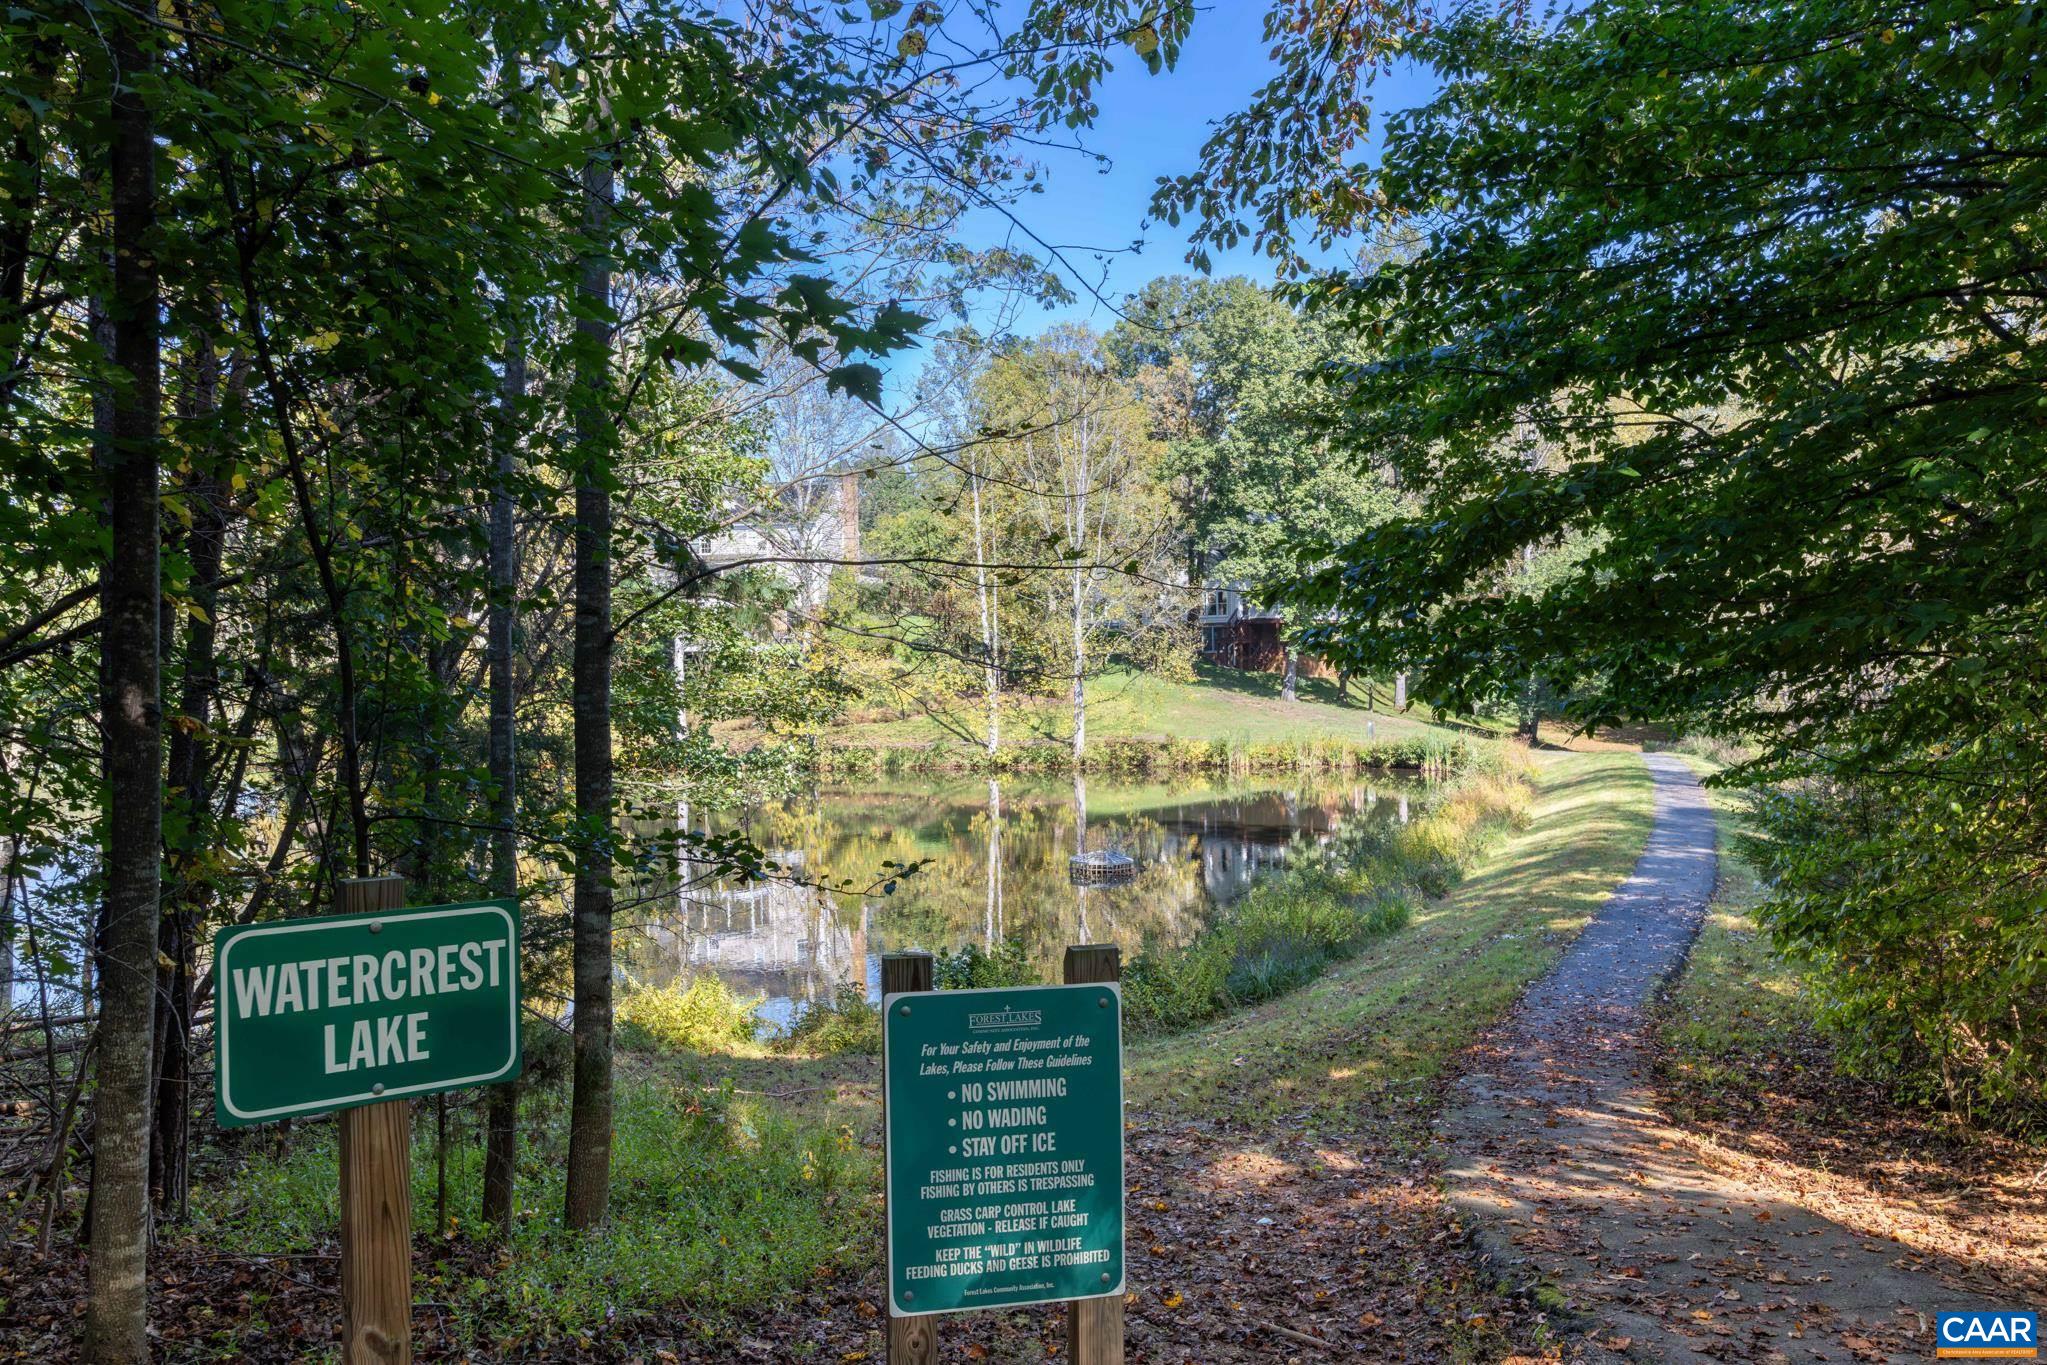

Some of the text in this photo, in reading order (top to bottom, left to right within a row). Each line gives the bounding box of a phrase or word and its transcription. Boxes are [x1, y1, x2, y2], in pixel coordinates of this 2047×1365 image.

[233, 939, 506, 1019] WATERCREST
[968, 1010, 1041, 1028] FOREST LAKES
[324, 1012, 429, 1074] LAKE
[921, 1035, 1090, 1056] For Your Safety and Enjoyment of the
[920, 1054, 1092, 1076] Lakes, Please Follow These Guidelines
[962, 1078, 1067, 1103] NO SWIMMING
[962, 1106, 1046, 1130] NO WADING
[962, 1132, 1056, 1158] STAY OFF ICE
[930, 1160, 1085, 1184] FISHING IS FOR RESIDENTS ONLY
[921, 1175, 1094, 1199] FISHING BY OTHERS IS TRESPASSING
[940, 1200, 1076, 1222] GRASS CARP CONTROL LAKE
[928, 1222, 985, 1239] VEGETATION
[995, 1216, 1036, 1233] RELEASE
[1040, 1216, 1048, 1228] IF
[1051, 1213, 1089, 1228] CAUGHT
[936, 1248, 960, 1262] KEEP
[963, 1246, 981, 1259] THE
[1024, 1242, 1035, 1253] IN
[1037, 1237, 1082, 1252] WILDLIFE
[906, 1249, 1110, 1280] FEEDING DUCKS AND GEESE IS PROHIBITED
[1019, 1283, 1045, 1291] Association,
